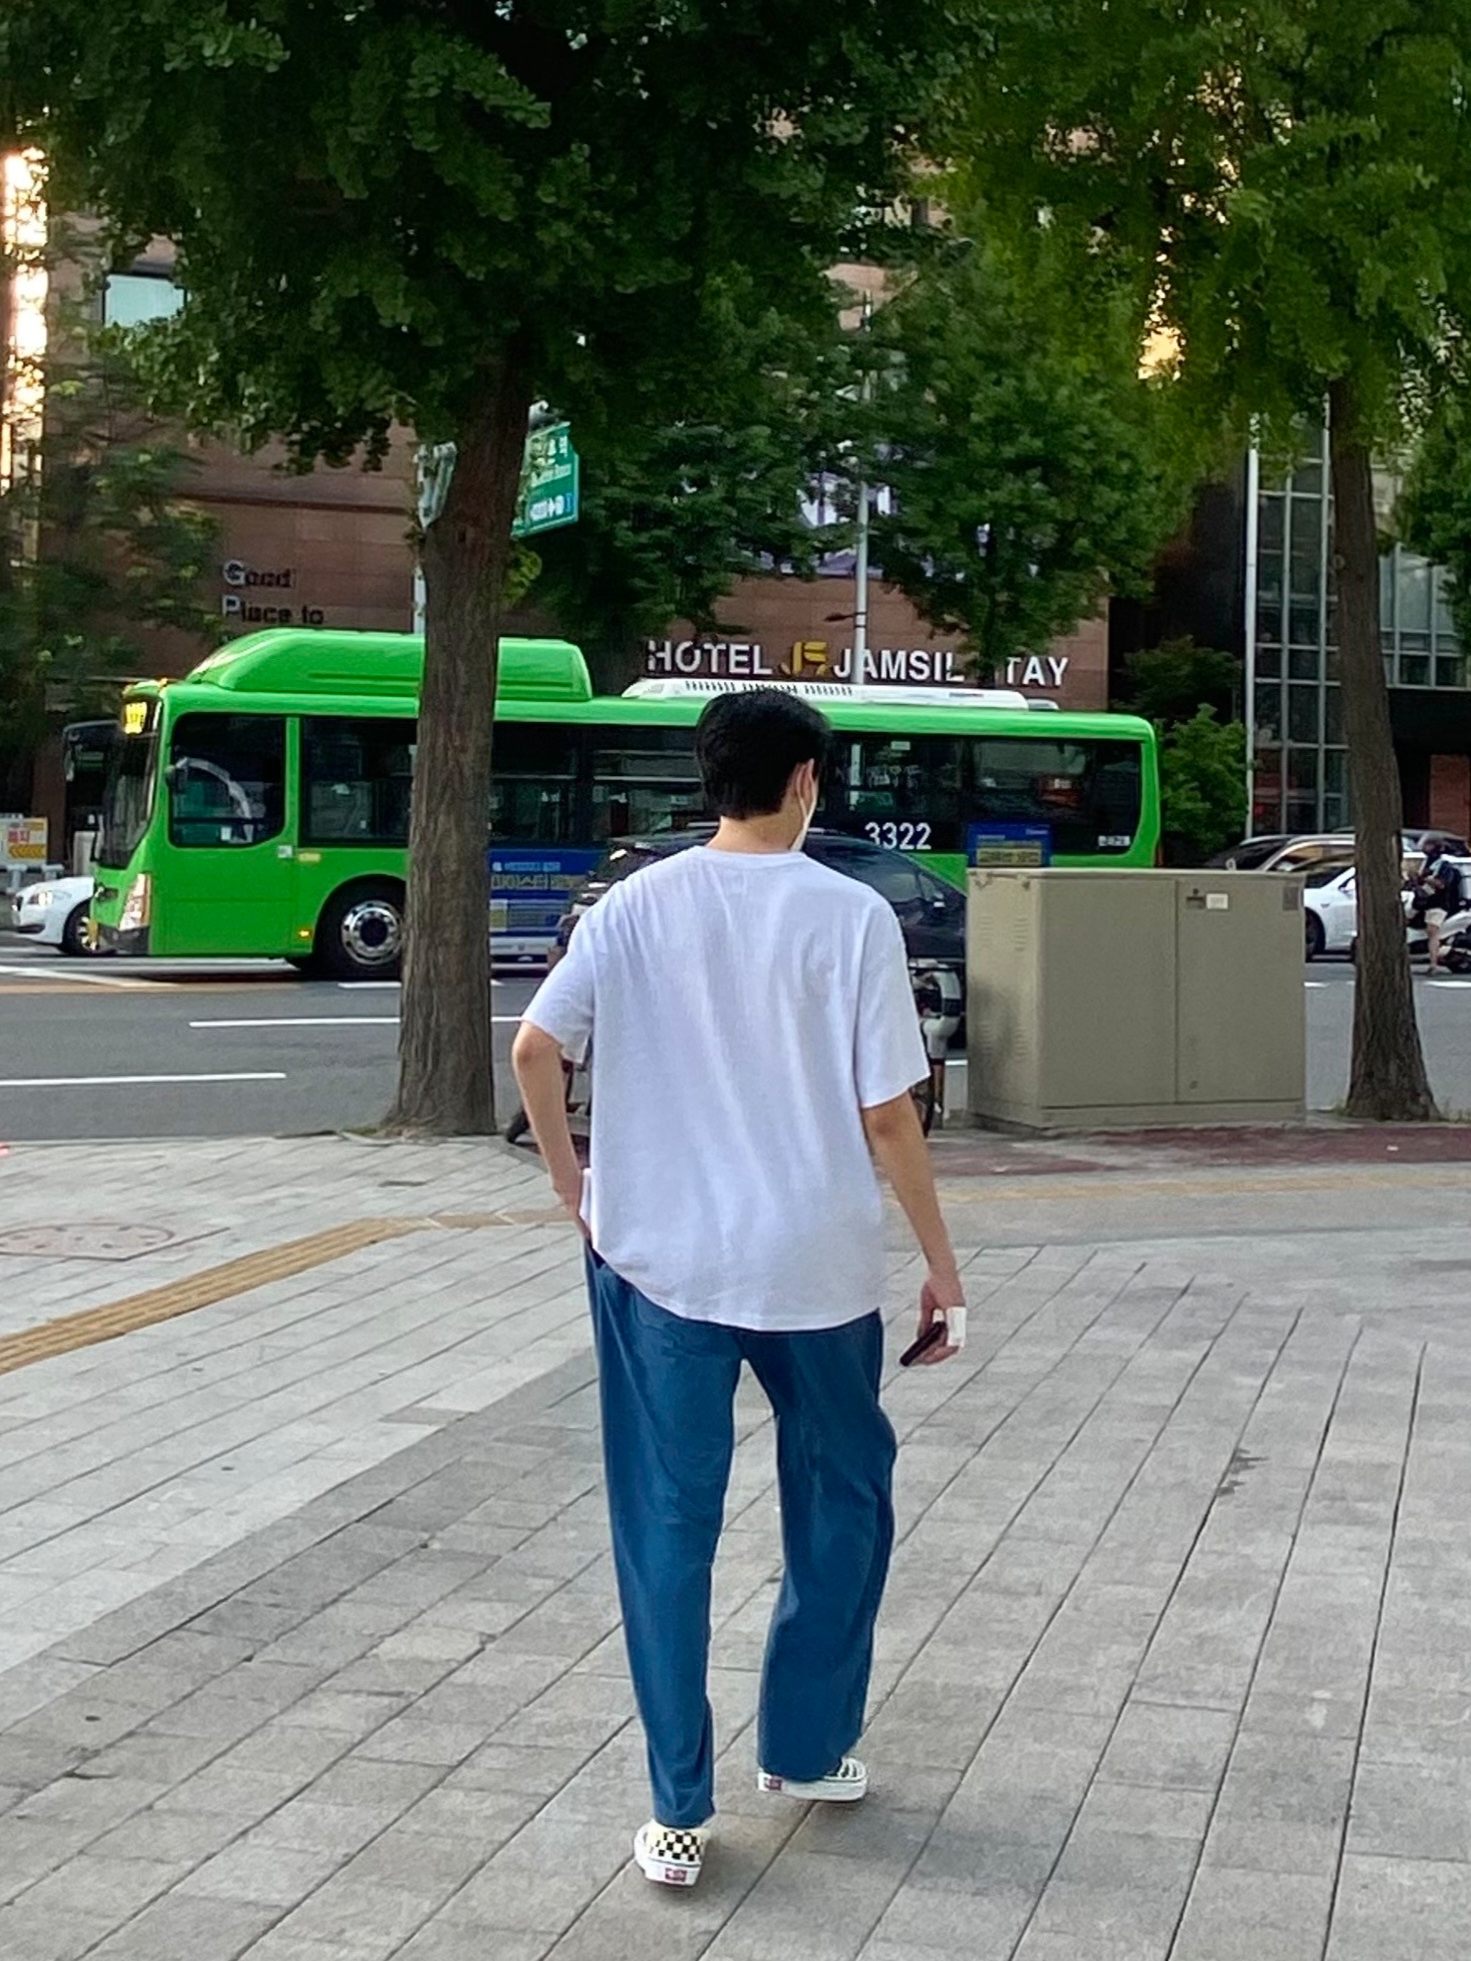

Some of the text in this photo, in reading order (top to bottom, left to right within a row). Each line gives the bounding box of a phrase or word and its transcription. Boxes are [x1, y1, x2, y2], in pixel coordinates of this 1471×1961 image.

[222, 595, 324, 625] Place to
[648, 640, 773, 676] HOTEL
[833, 648, 965, 683] JAMSIL
[994, 656, 1069, 687] TAY
[864, 822, 932, 850] 3322
